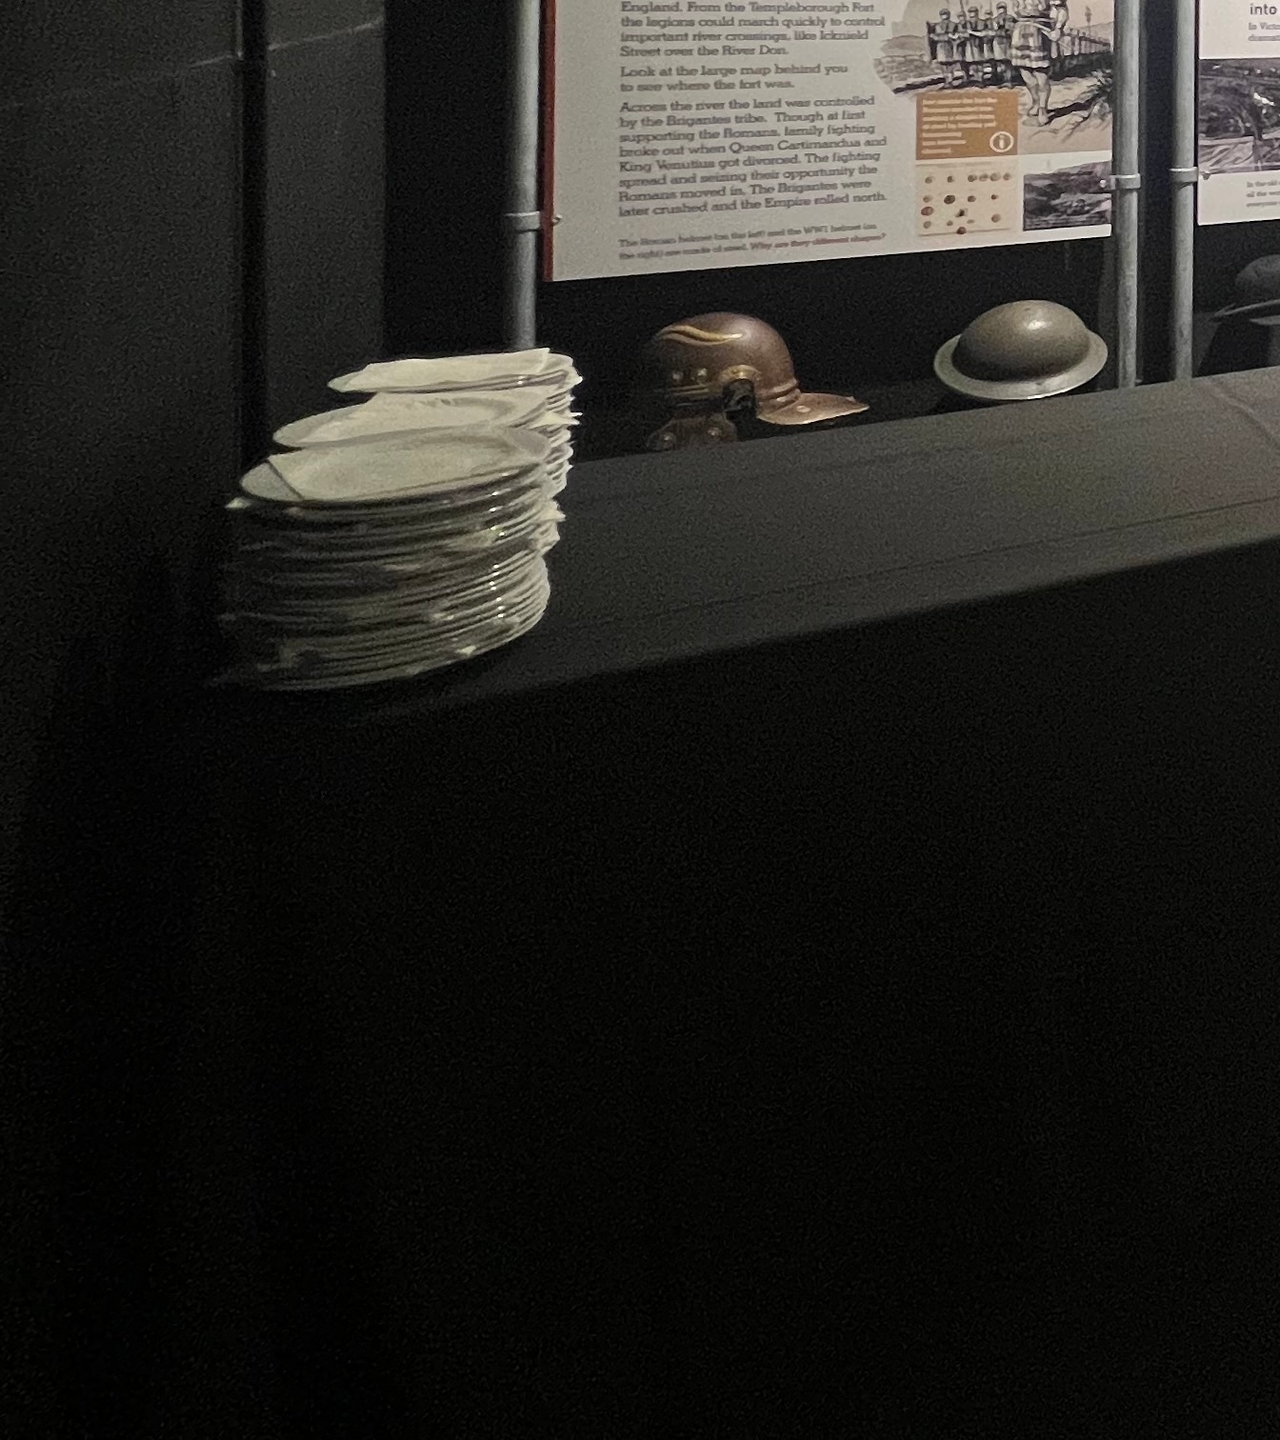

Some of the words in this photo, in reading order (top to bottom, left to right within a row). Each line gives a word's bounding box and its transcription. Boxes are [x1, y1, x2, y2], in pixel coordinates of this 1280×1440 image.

[621, 1, 683, 14] England.
[687, 2, 721, 12] From
[725, 2, 745, 12] the
[748, 2, 849, 15] Templeborough
[852, 2, 874, 12] Fort
[1250, 3, 1277, 15] into
[621, 16, 643, 27] the
[646, 16, 695, 29] legions
[698, 16, 735, 27] could
[738, 16, 779, 27] march
[782, 16, 827, 29] quickly
[830, 18, 842, 26] to
[844, 16, 885, 26] control
[620, 32, 689, 44] important
[692, 31, 722, 41] river
[794, 31, 817, 40] like
[620, 46, 661, 57] Street
[697, 46, 719, 56] the
[722, 45, 756, 55] River
[759, 45, 789, 55] Don.
[621, 66, 656, 77] Look
[659, 67, 673, 76] at
[676, 66, 699, 76] the
[700, 65, 737, 77] large
[740, 67, 772, 76] map
[774, 63, 821, 74] behind
[824, 66, 848, 76] you
[620, 84, 634, 92] to
[637, 84, 663, 92] see
[666, 80, 711, 91] where
[714, 80, 736, 90] the
[739, 79, 761, 89] fort
[620, 102, 667, 112] Across
[670, 101, 693, 111] the
[695, 102, 726, 110] river
[728, 99, 750, 109] the
[753, 98, 782, 109] land
[813, 95, 875, 107] controlled
